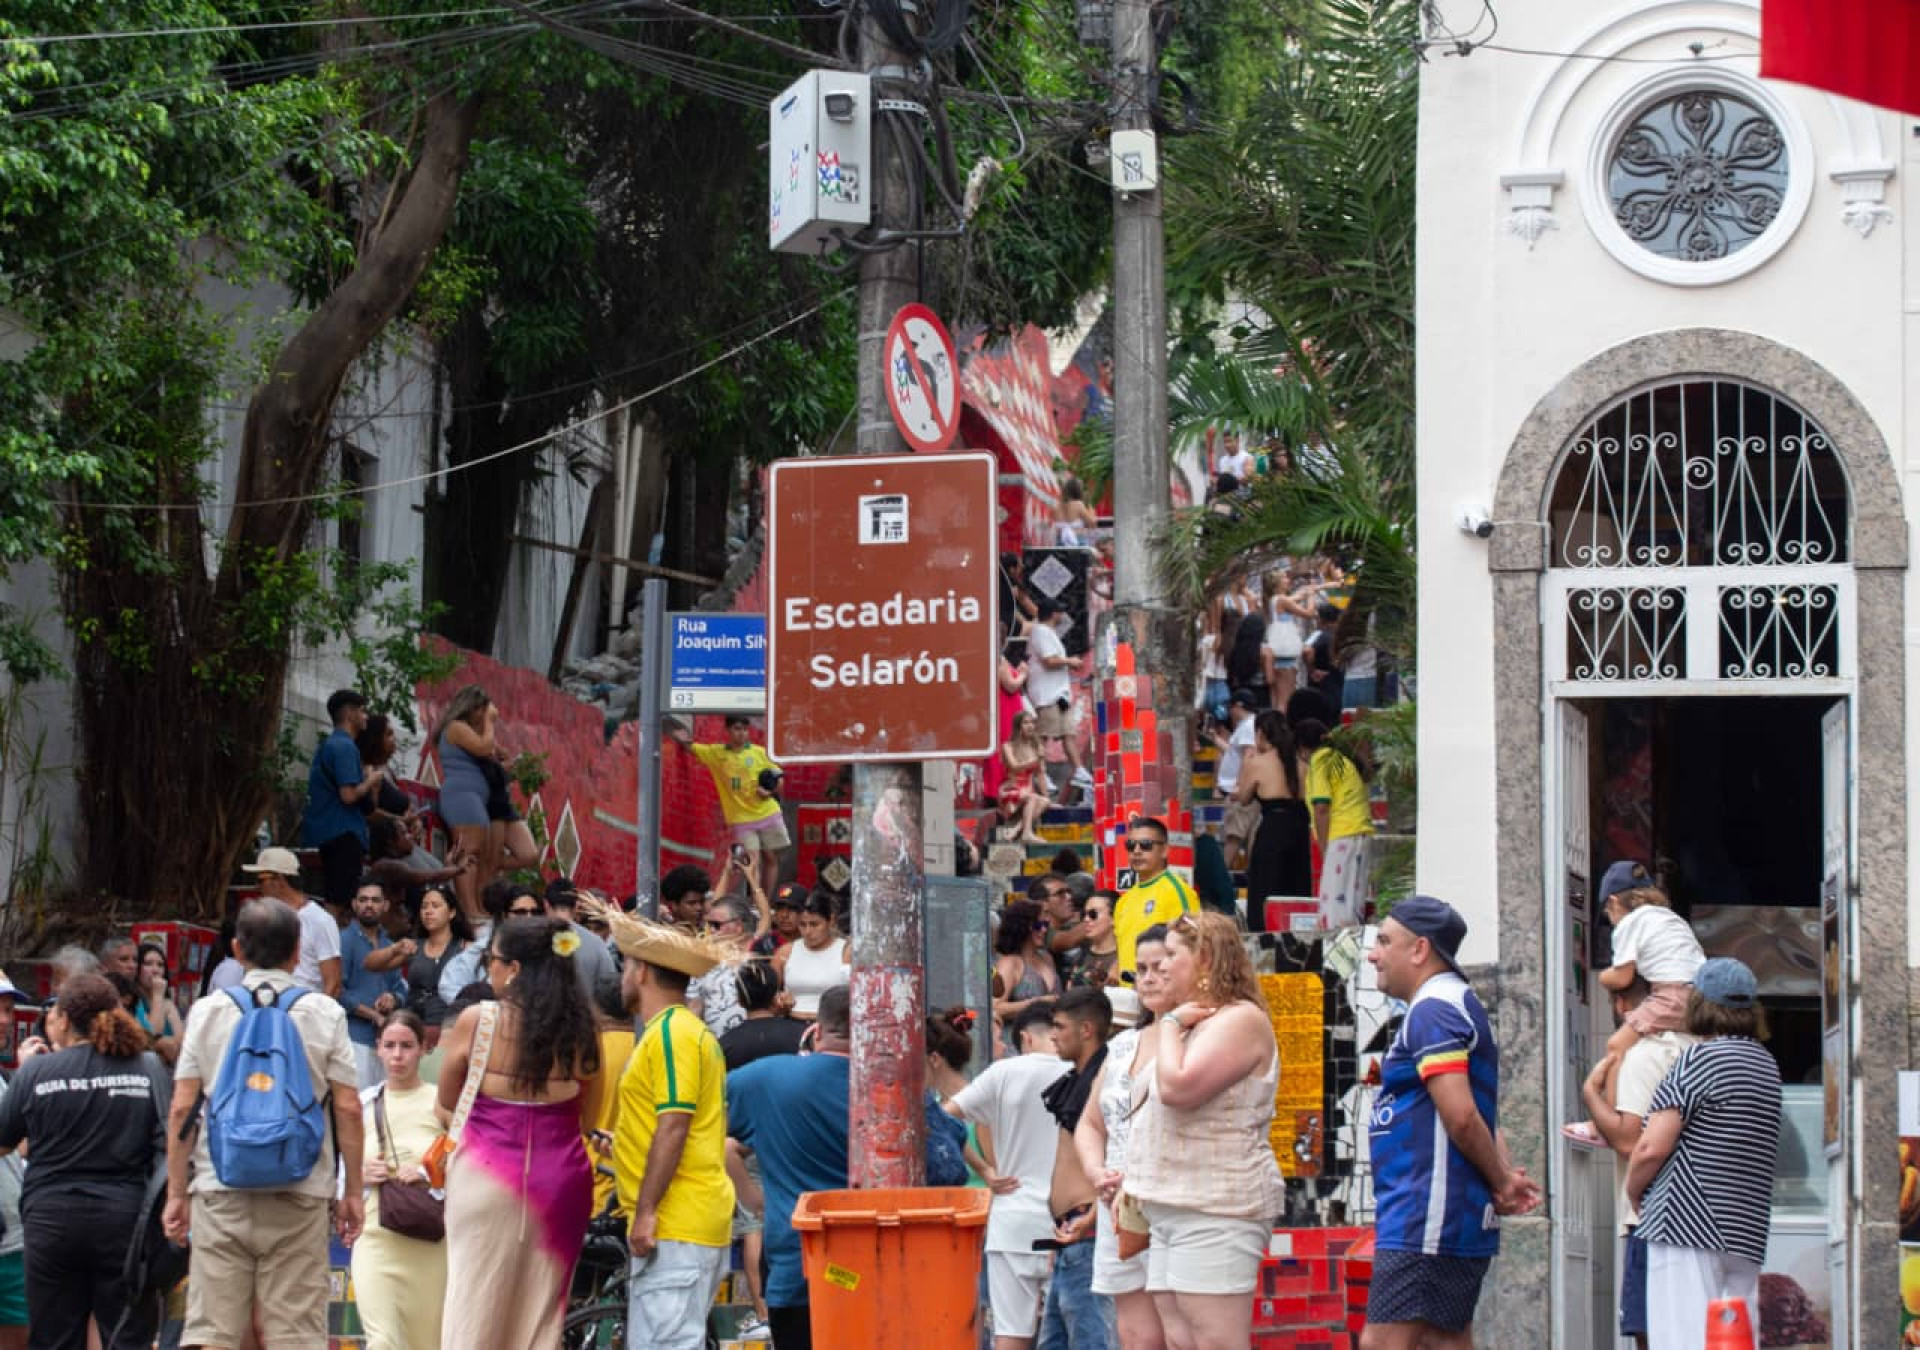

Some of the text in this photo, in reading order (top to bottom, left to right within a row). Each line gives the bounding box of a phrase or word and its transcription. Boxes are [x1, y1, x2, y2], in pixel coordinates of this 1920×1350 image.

[785, 590, 980, 631] Escadaria
[678, 618, 707, 633] Rua
[677, 633, 741, 652] Joaquim
[810, 651, 959, 688] Selarón
[674, 692, 694, 707] 93
[35, 1074, 151, 1096] GUIA DE TURISMO
